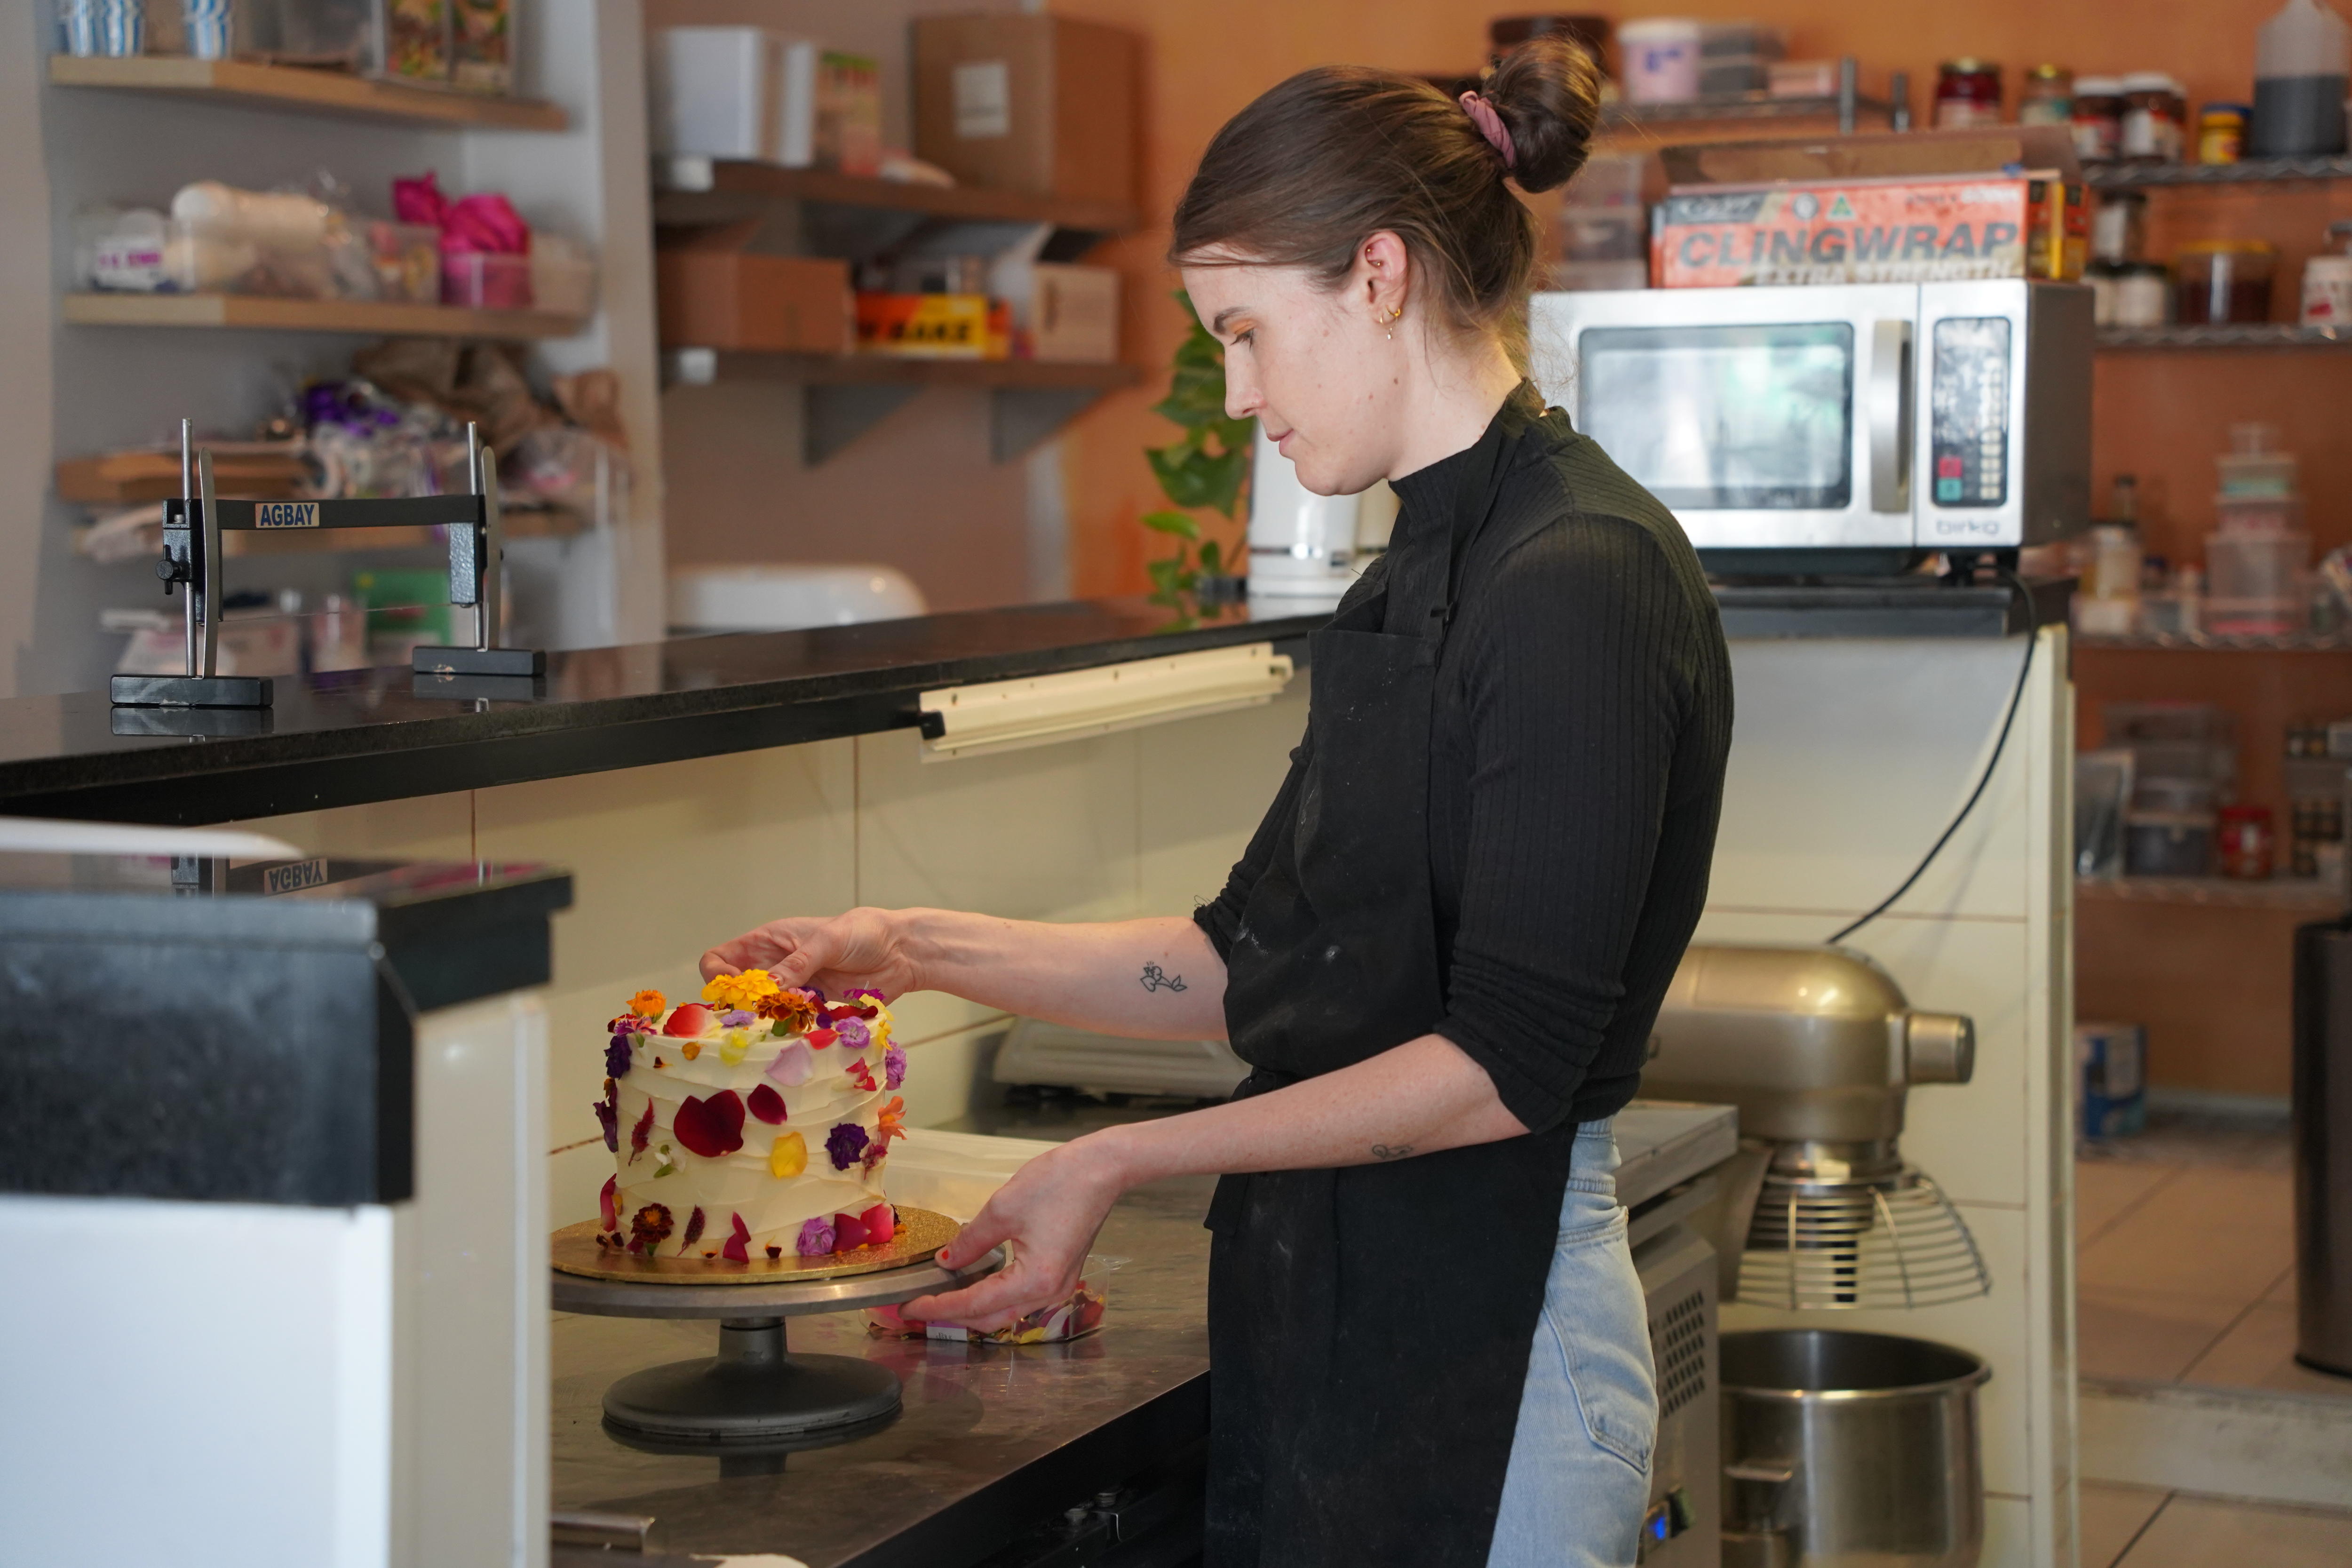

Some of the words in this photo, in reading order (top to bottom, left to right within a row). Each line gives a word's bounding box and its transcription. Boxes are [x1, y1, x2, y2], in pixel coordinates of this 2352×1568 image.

[1679, 222, 2018, 268] CLINGWRAP
[1754, 261, 1845, 286] EXTRA
[1851, 257, 2012, 283] STRENGTH
[260, 504, 315, 526] AGBAY
